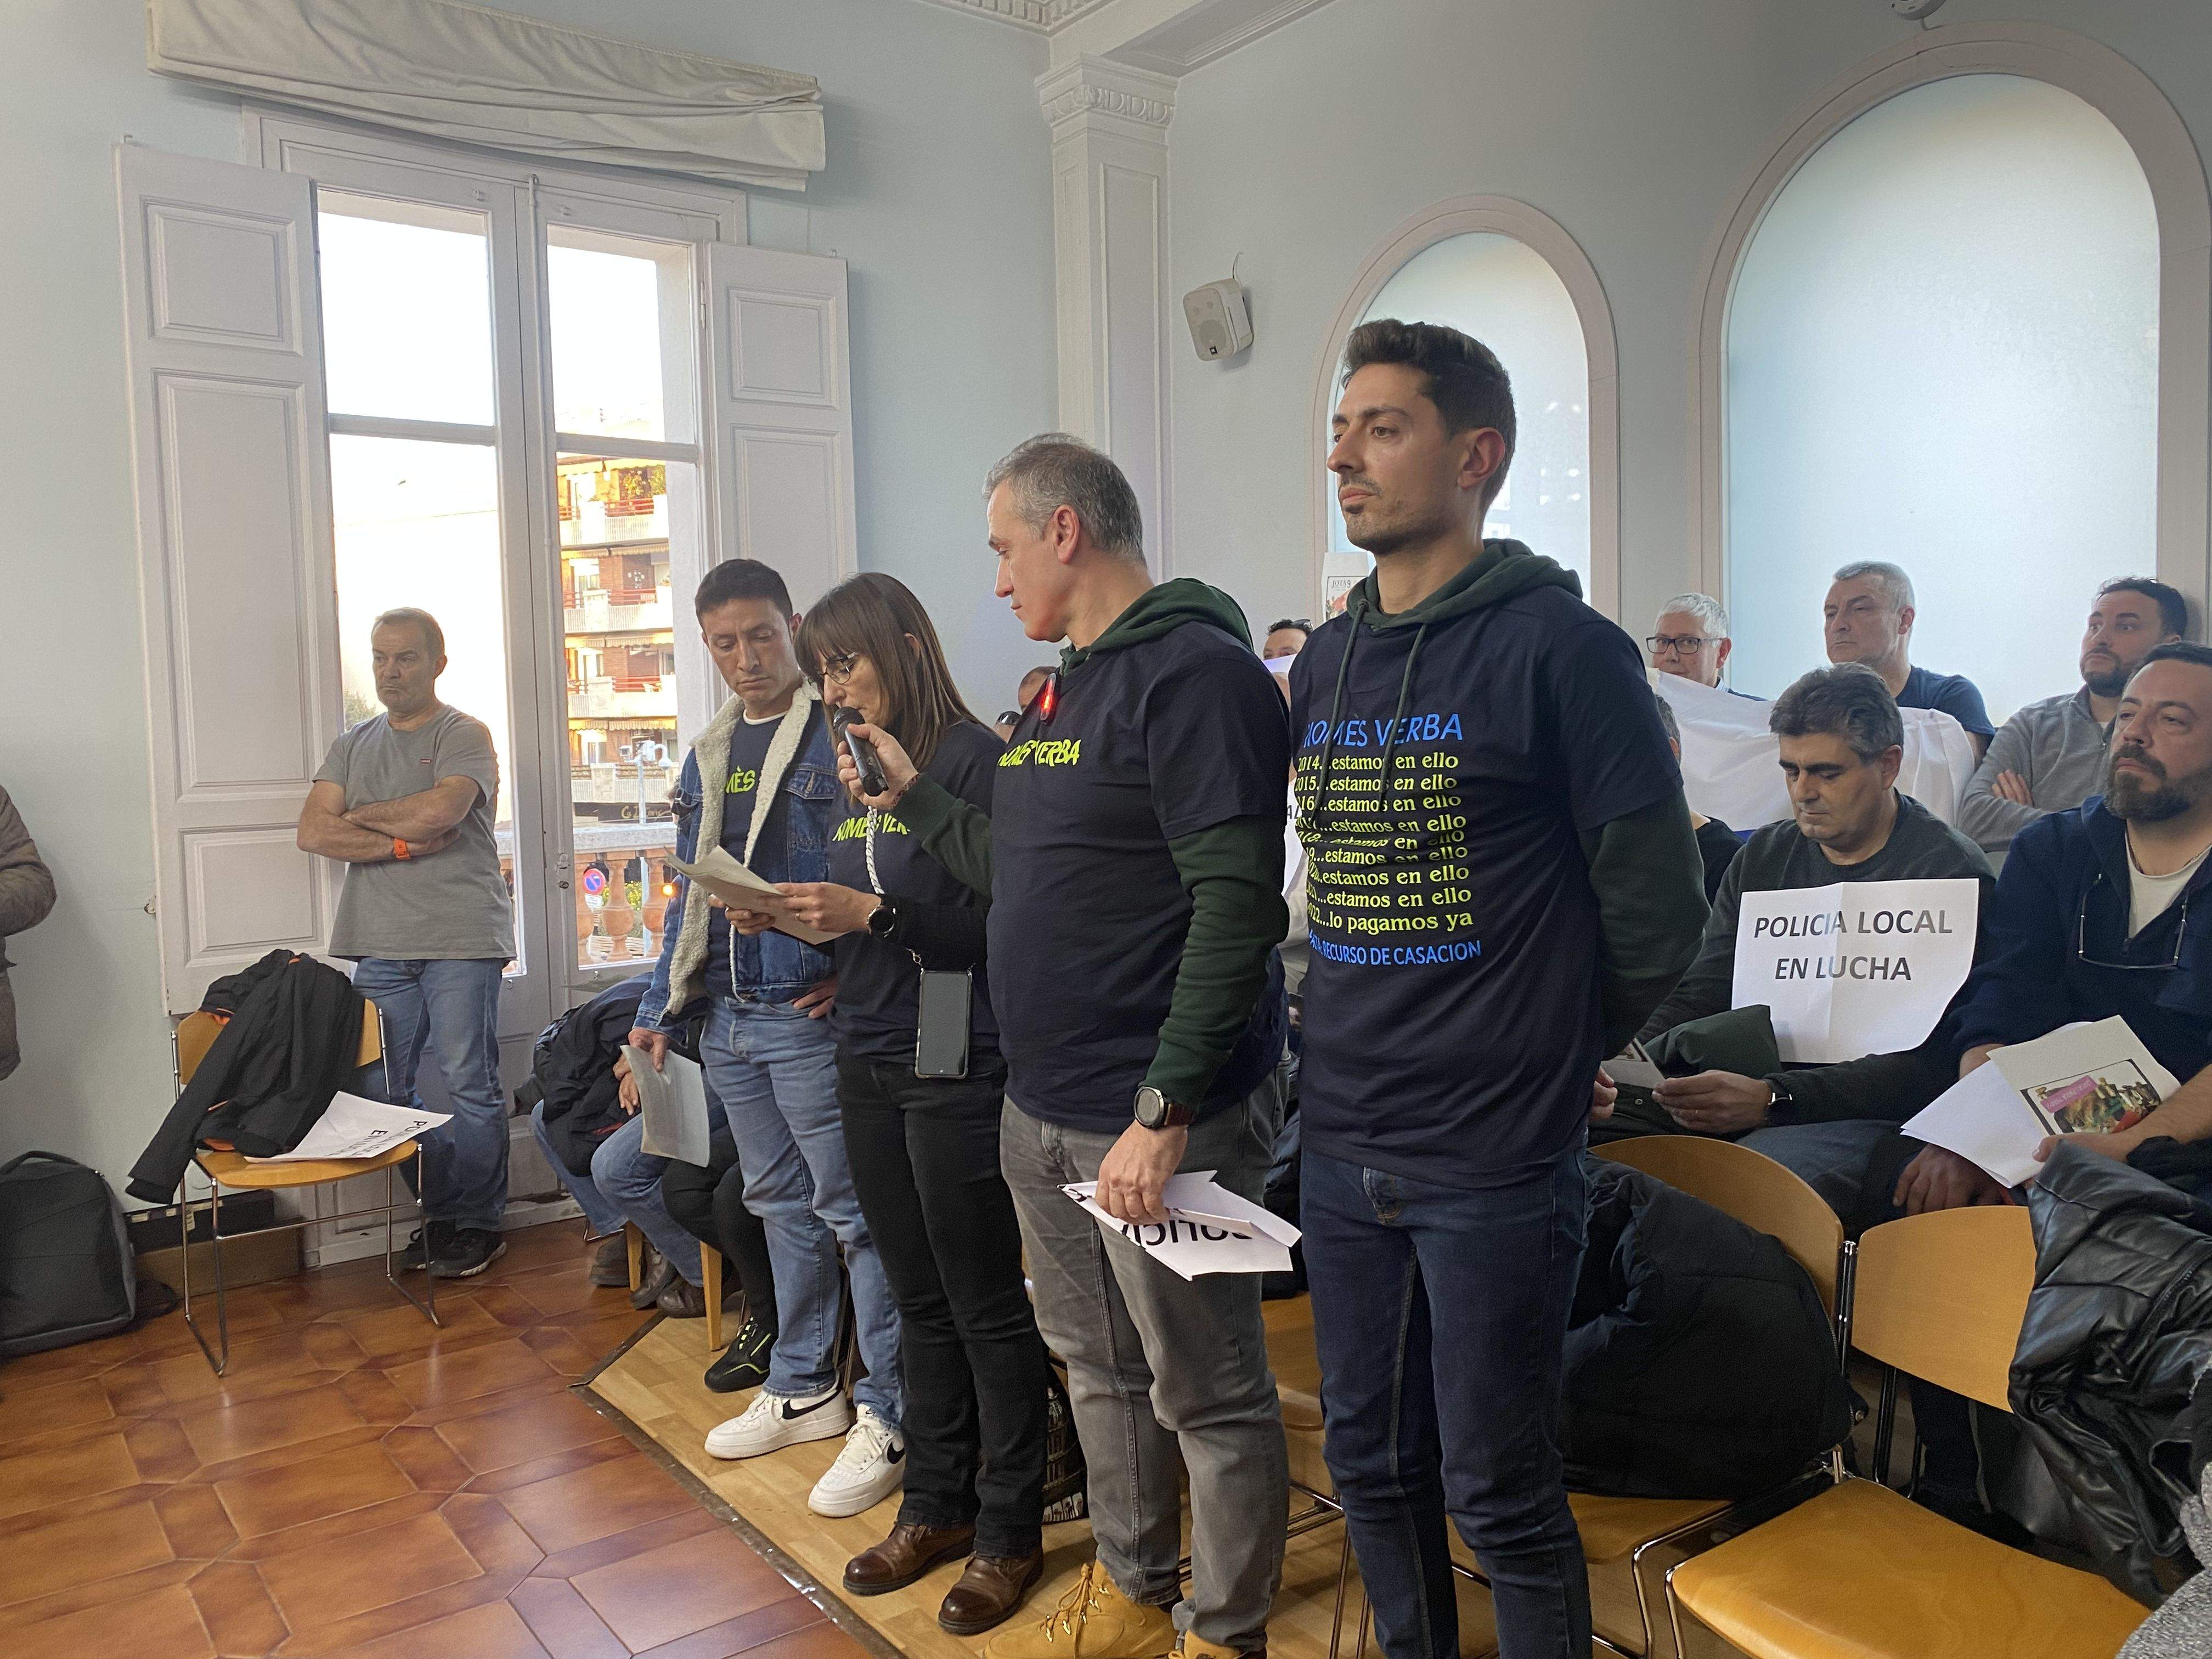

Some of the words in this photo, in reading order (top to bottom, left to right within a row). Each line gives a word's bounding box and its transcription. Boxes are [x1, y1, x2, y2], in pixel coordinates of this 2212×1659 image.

[1374, 713, 1463, 746] VERBA
[1034, 739, 1082, 766] VERBA
[1395, 756, 1416, 769] en
[1421, 752, 1458, 768] ello
[1394, 777, 1414, 790] en
[1420, 774, 1457, 790] ello
[1393, 798, 1416, 811] en
[1423, 795, 1462, 809] ello
[882, 812, 911, 834] VER
[1398, 821, 1421, 832] en
[1427, 814, 1466, 831] ello
[1394, 837, 1418, 849] en
[1427, 830, 1464, 845] ello
[1395, 854, 1419, 863] en
[1429, 846, 1468, 861] ello
[1396, 871, 1421, 884] en
[1430, 865, 1469, 882] ello
[1397, 894, 1424, 907] en
[1431, 887, 1471, 905] ello
[1347, 916, 1438, 935] pagamos
[1445, 912, 1474, 932] ya
[1754, 911, 1847, 938] POLICIA
[1858, 910, 1953, 934] LOCAL
[1322, 940, 1367, 964] RECURSO
[1370, 947, 1391, 965] DE
[1393, 940, 1481, 965] CASACION
[1775, 957, 1808, 980] EN
[1816, 956, 1912, 981] LUCHA
